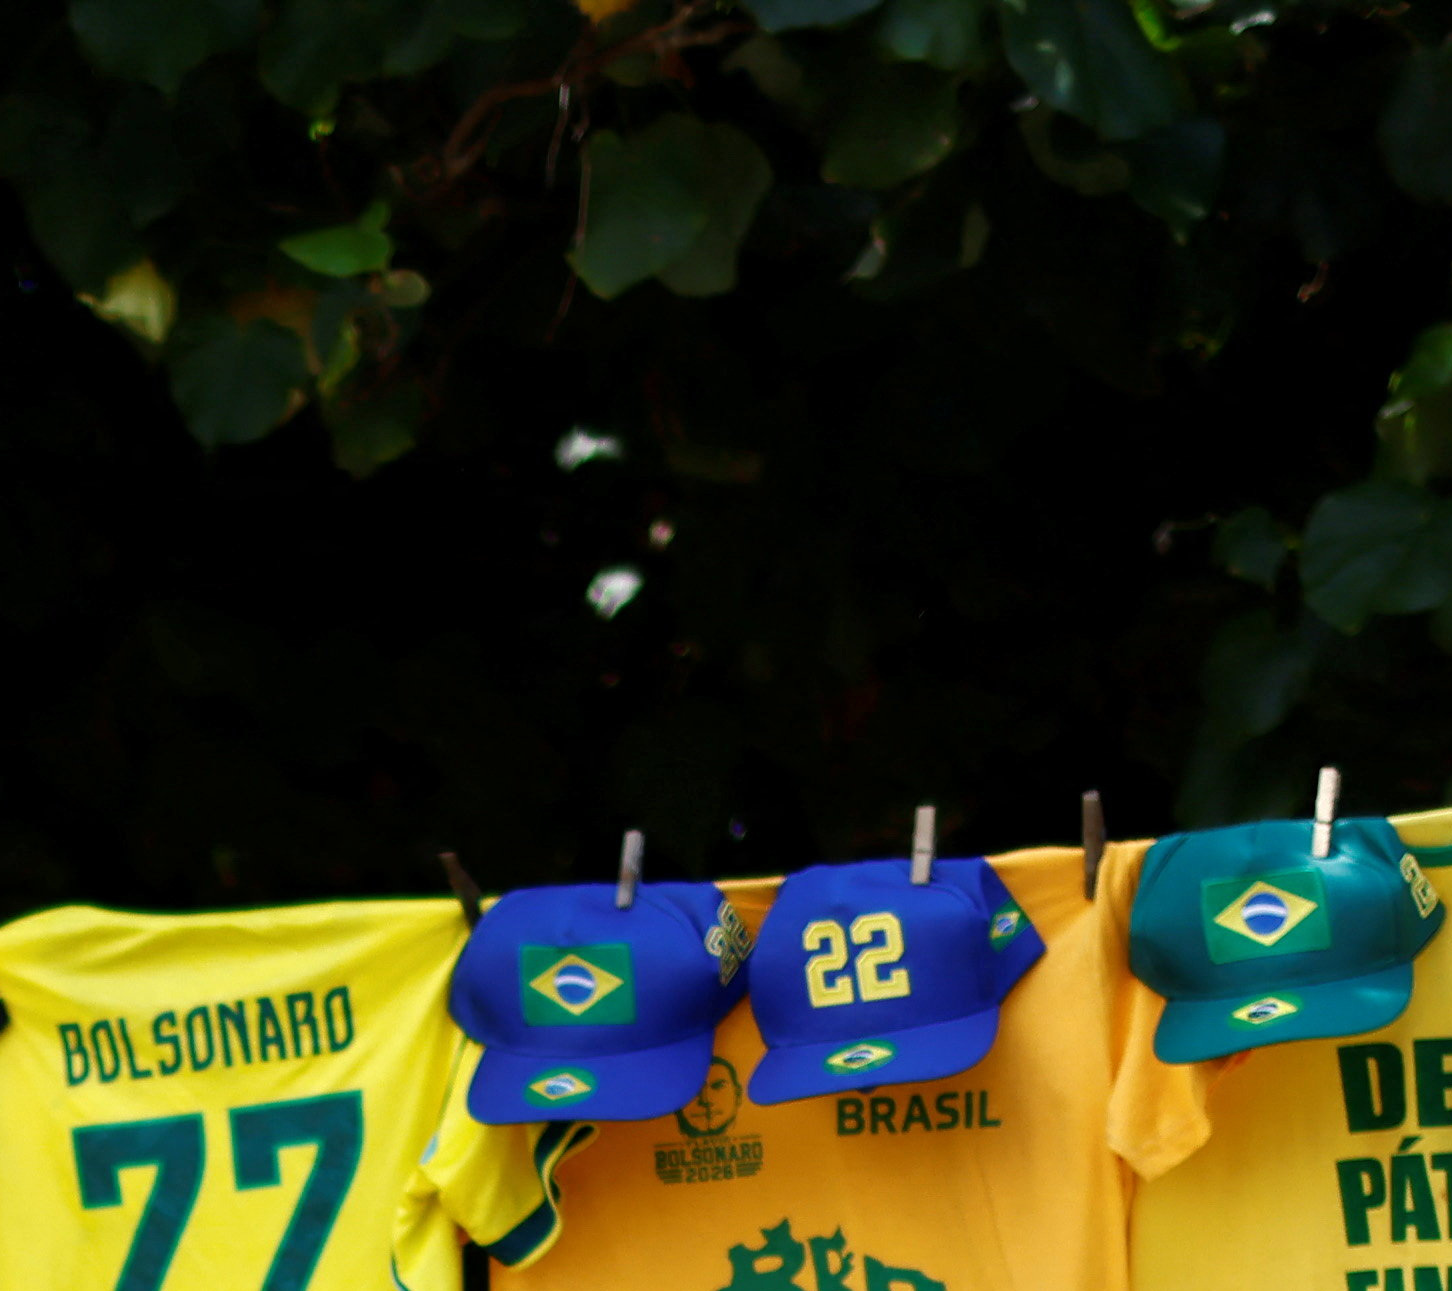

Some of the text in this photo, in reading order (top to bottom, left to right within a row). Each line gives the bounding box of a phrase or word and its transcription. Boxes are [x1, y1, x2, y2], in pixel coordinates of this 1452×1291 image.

[803, 912, 911, 1008] 22
[57, 986, 356, 1087] BOLSONARO
[836, 1089, 1002, 1136] BRASIL
[654, 1141, 763, 1170] BOLSONARO
